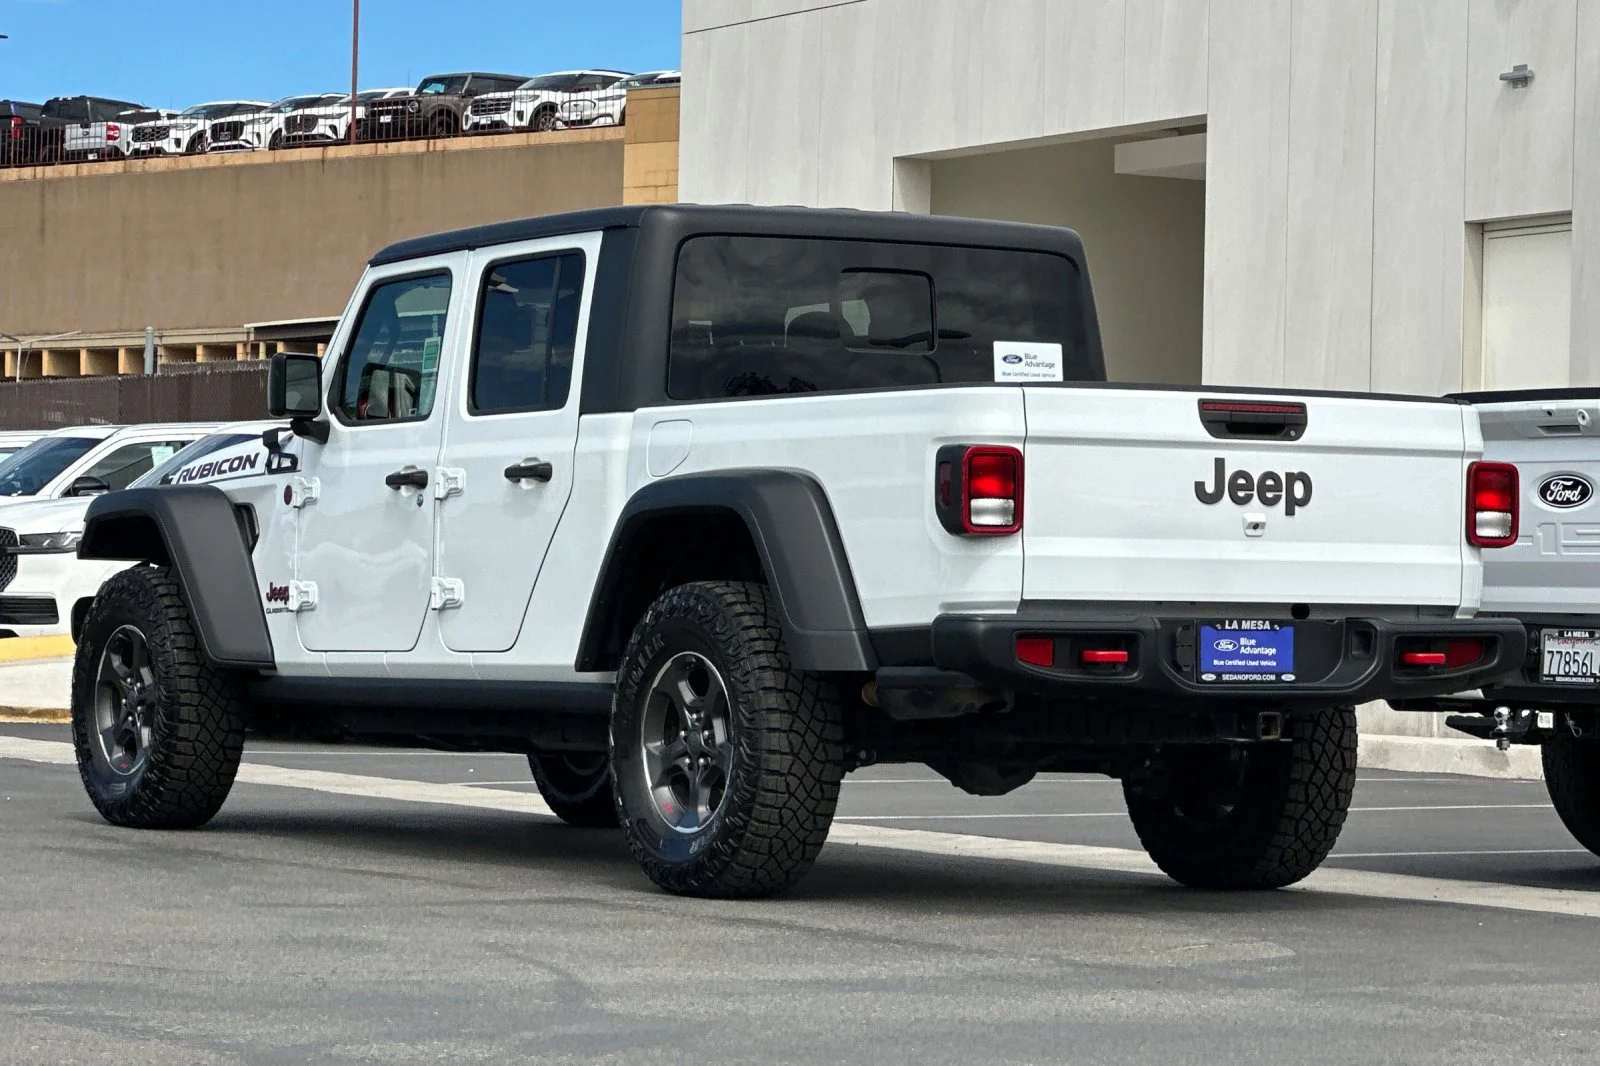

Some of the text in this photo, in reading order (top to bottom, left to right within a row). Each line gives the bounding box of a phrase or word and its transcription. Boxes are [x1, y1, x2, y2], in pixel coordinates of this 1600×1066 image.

[1025, 361, 1055, 369] Advantage
[176, 452, 260, 483] RUBICON
[1194, 457, 1313, 516] Jeep
[1546, 480, 1582, 502] Ford
[266, 582, 290, 605] Jeep
[1225, 620, 1270, 630] LA MESA
[1218, 641, 1235, 650] Ford
[1240, 638, 1256, 646] Blue
[1240, 646, 1276, 655] Advantage
[1547, 650, 1600, 676] 77856L
